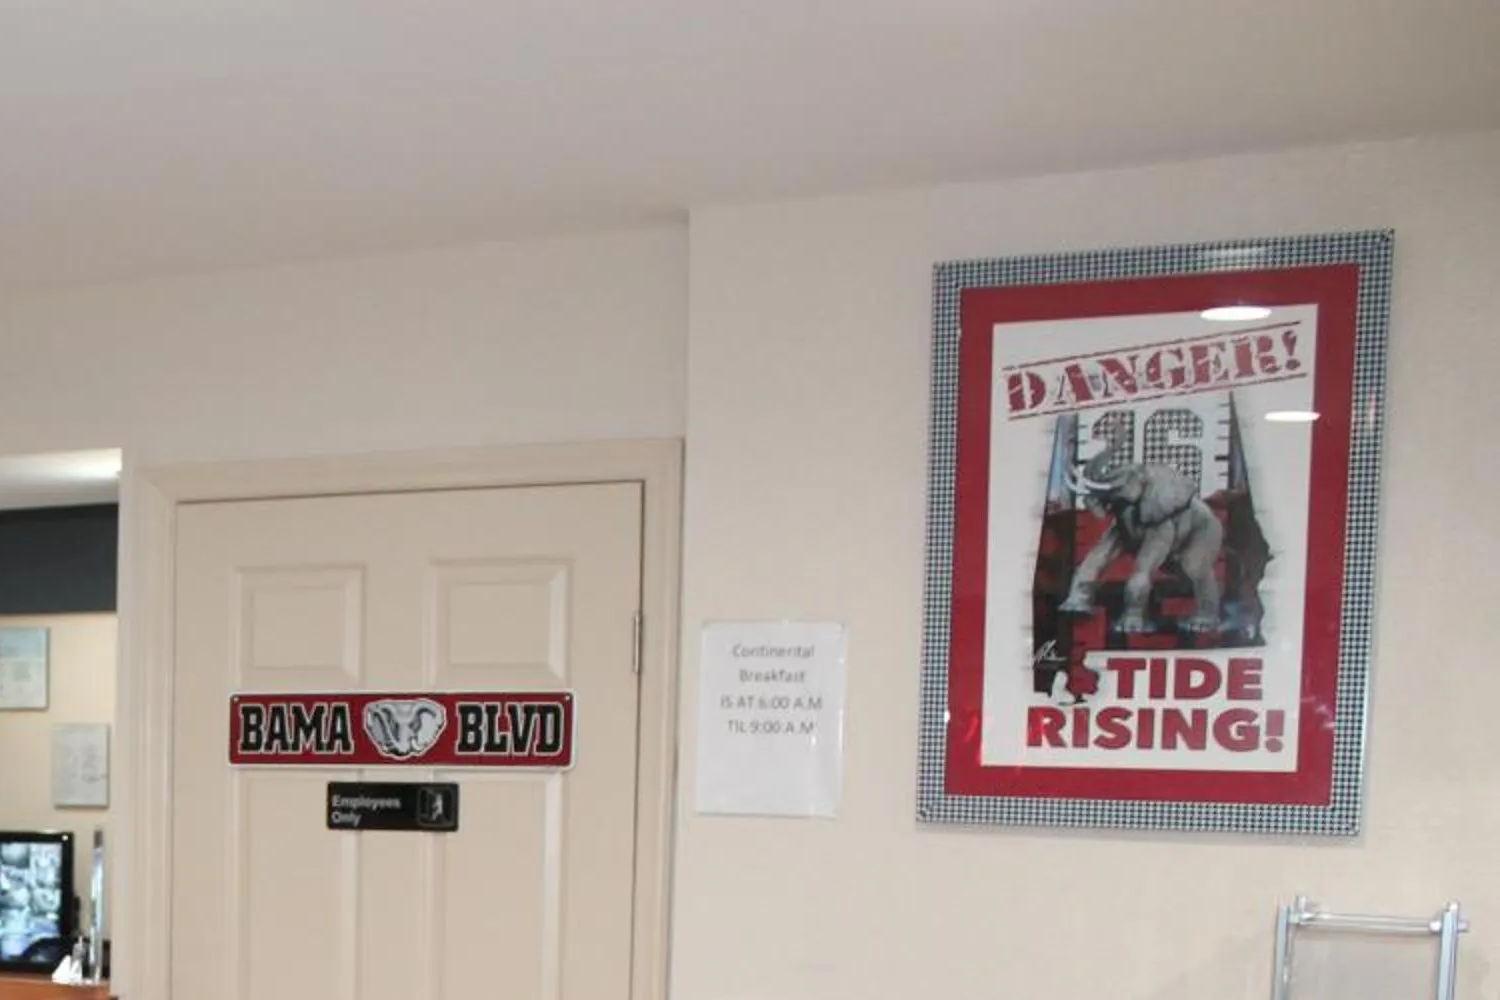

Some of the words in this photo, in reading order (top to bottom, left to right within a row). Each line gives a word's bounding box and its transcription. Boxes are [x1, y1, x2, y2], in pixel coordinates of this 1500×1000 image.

[1006, 329, 1301, 413] DANGER!
[732, 644, 815, 658] Continental
[739, 669, 806, 683] Breakfast
[1106, 657, 1265, 700] TIDE
[737, 695, 754, 709] AT
[239, 702, 354, 754] BAMA
[455, 702, 565, 755] BLVD
[1026, 705, 1286, 754] RISING!
[332, 794, 401, 811] Employees
[331, 811, 361, 828] Only
